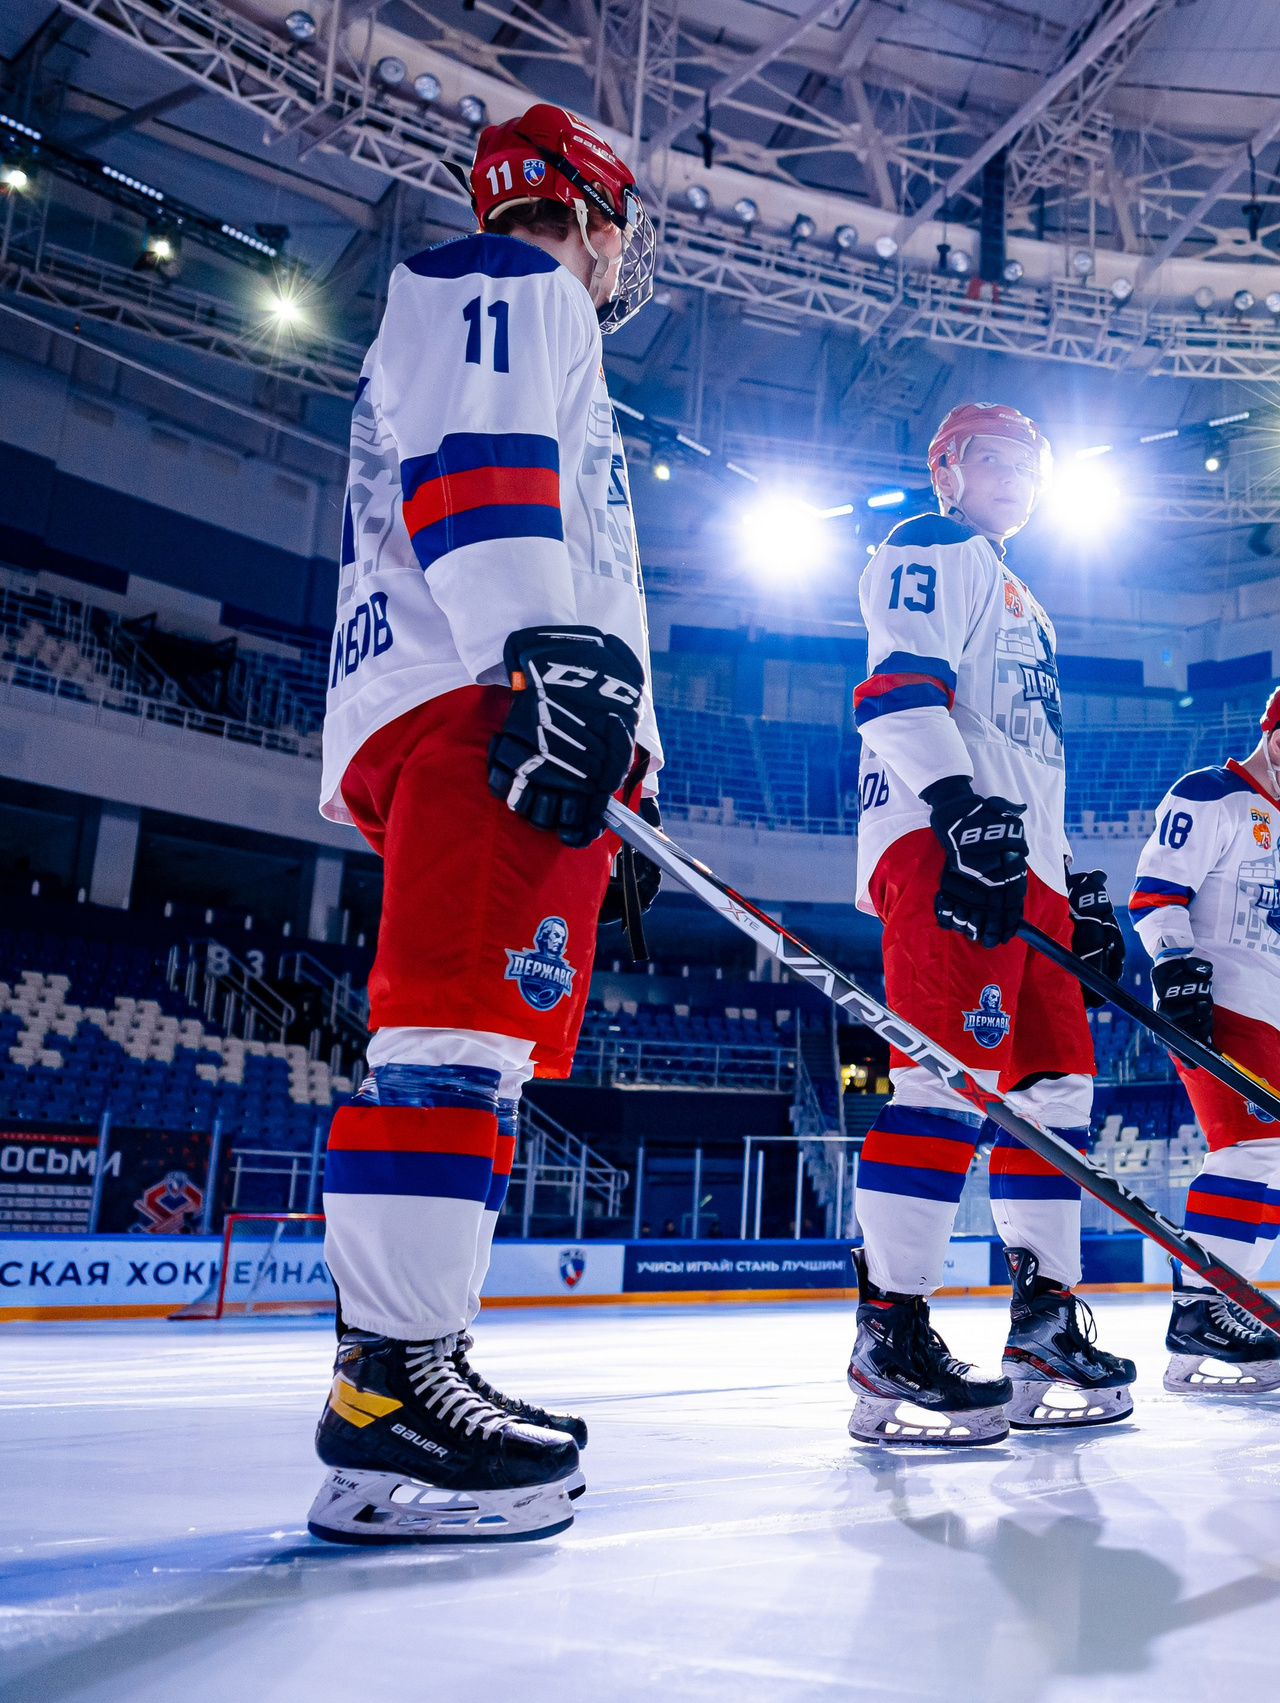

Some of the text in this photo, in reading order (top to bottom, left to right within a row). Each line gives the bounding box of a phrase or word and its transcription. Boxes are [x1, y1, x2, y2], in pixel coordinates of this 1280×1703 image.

[486, 161, 513, 196] 11
[462, 296, 510, 374] 11
[889, 562, 937, 614] 13
[1159, 809, 1194, 850] 18
[776, 932, 960, 1088] VAPOR
[0, 1261, 109, 1287] СКАЯ
[736, 1260, 780, 1272] СТАНЬ
[391, 1423, 449, 1458] BAUER
